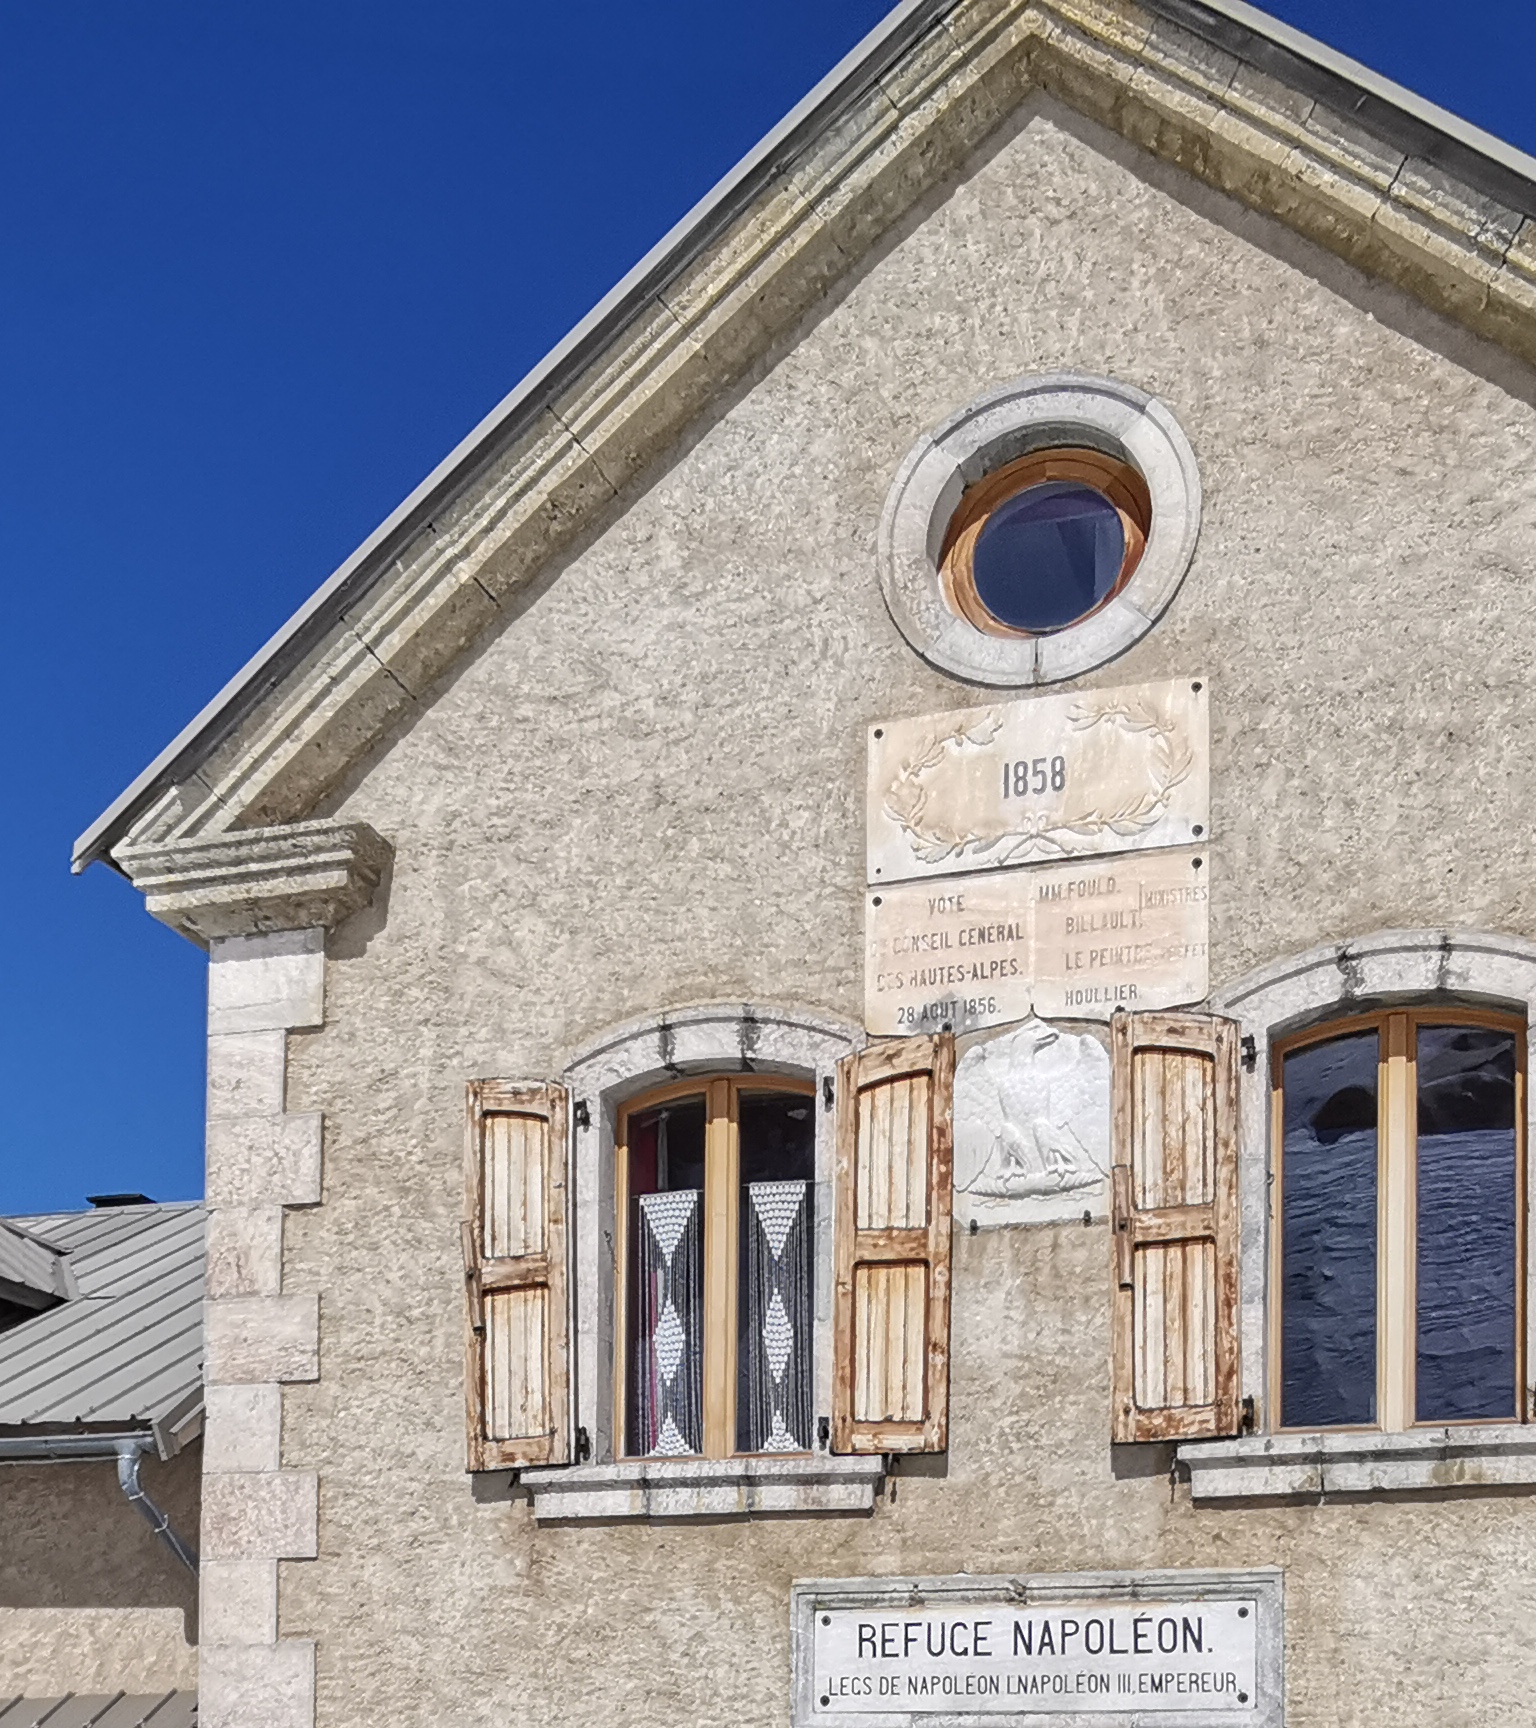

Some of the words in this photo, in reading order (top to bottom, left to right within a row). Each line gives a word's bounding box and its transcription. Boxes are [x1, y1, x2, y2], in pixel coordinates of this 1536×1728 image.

[1003, 756, 1066, 799] 1858
[1066, 952, 1084, 971] LE
[897, 1006, 915, 1024] 28
[858, 1621, 993, 1658] REFUGE
[1013, 1612, 1214, 1656] NAPOLÉON.
[879, 1675, 901, 1696] DE
